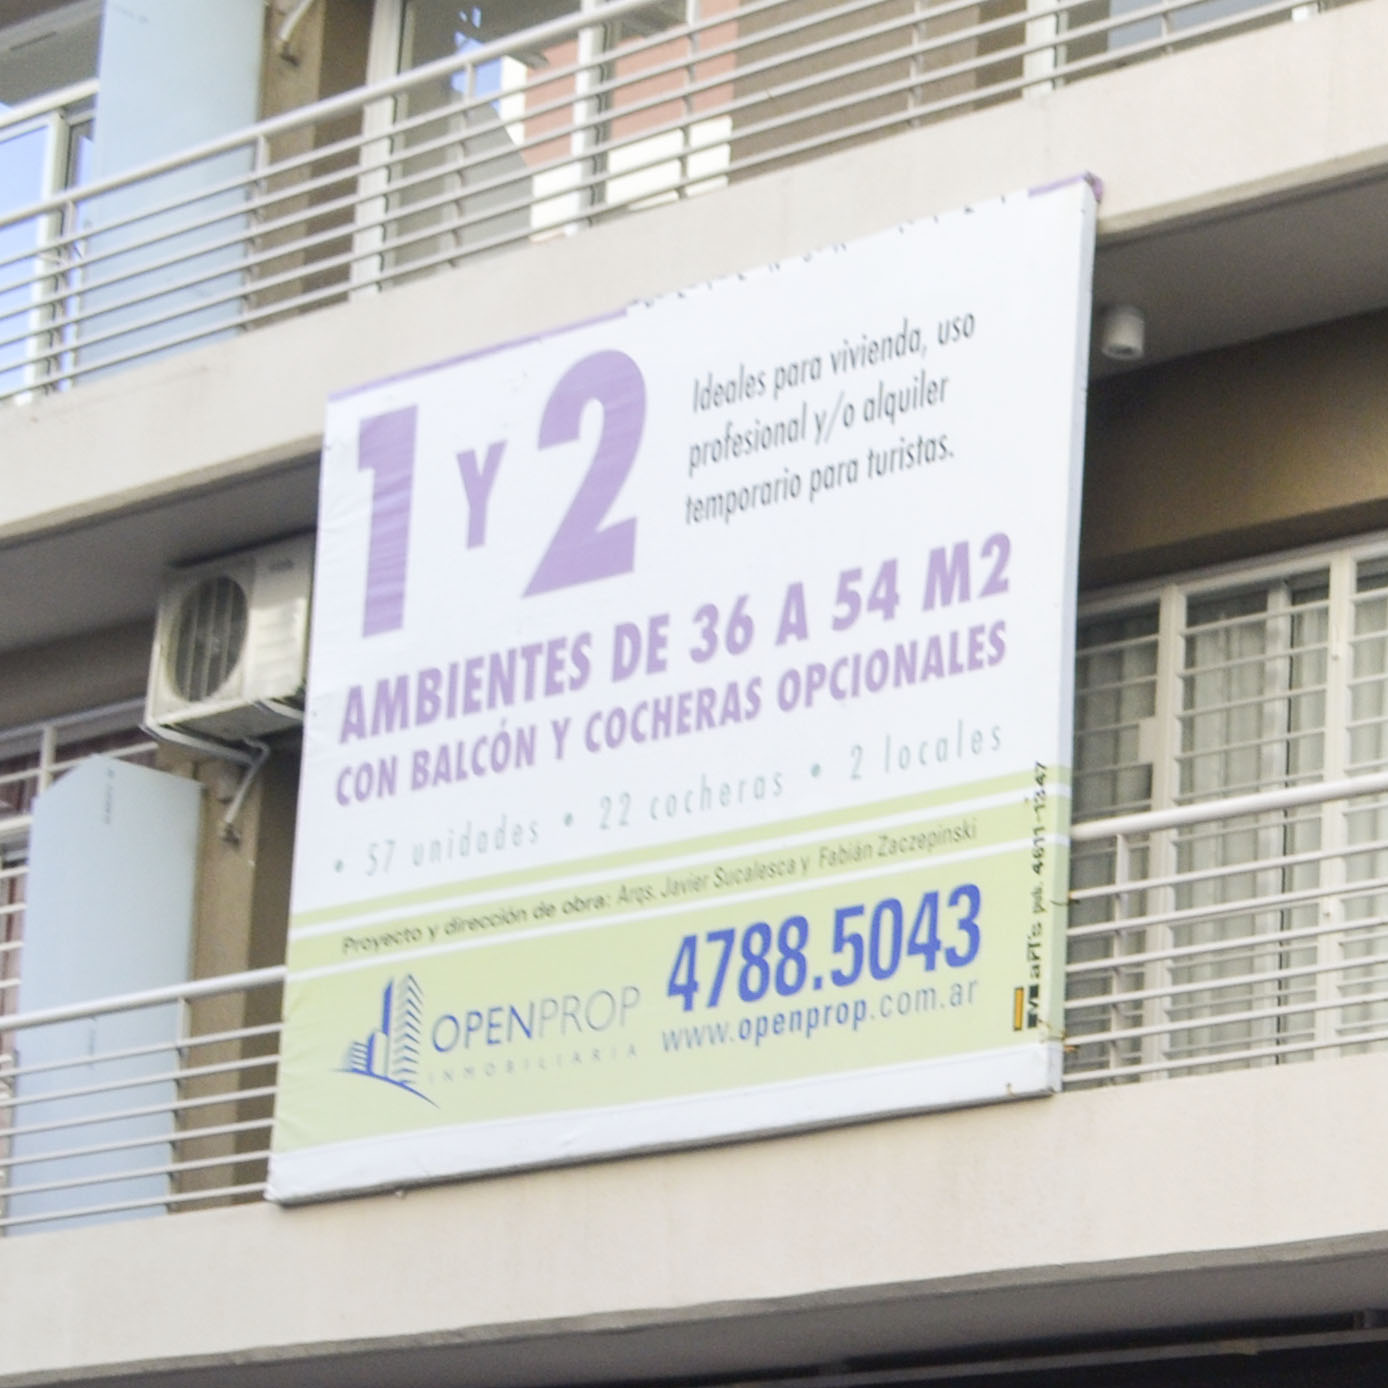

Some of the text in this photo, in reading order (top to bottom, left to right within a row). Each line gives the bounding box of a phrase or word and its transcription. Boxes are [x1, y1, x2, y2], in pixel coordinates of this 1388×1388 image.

[693, 312, 976, 413] Ideales para vivienda, uso
[689, 368, 949, 478] profesional y/o alquiler
[357, 349, 648, 638] 1 Y 2
[685, 433, 954, 525] temporario para turistas.
[339, 532, 1012, 745] AMBIENTES DE 36 A 54 M2
[336, 619, 1007, 807] CON BALCÓN Y COCHERAS OPCIONALES
[365, 718, 1002, 877] 57 unidades 22 cocheras 2 locales
[342, 925, 423, 955] Proyecto
[428, 923, 440, 943] y
[532, 900, 557, 920] de
[660, 872, 708, 899] Javier
[799, 856, 809, 876] y
[666, 883, 982, 1013] 4788.5043
[431, 985, 641, 1053] OPENPROP
[662, 978, 978, 1053] www.openprop.com.ar
